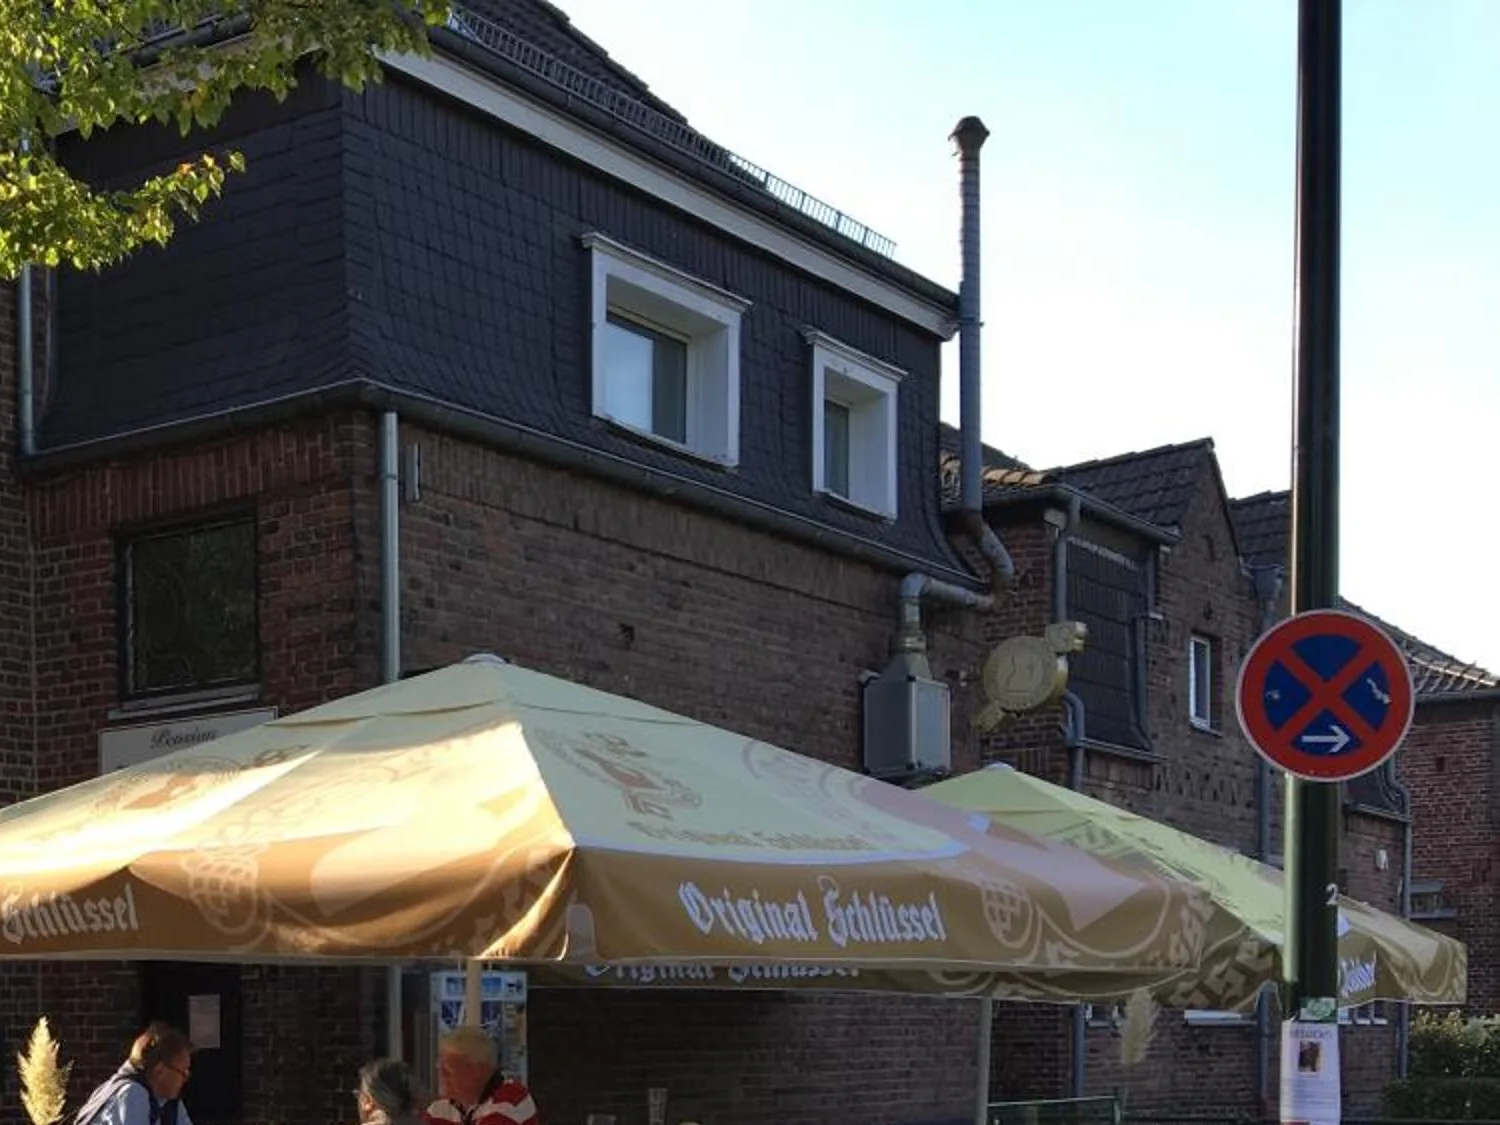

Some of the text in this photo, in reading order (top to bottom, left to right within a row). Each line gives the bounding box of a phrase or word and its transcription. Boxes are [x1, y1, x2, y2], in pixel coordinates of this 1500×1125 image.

[1, 881, 139, 945] Schlüssel
[676, 875, 947, 948] Original Schlüssel
